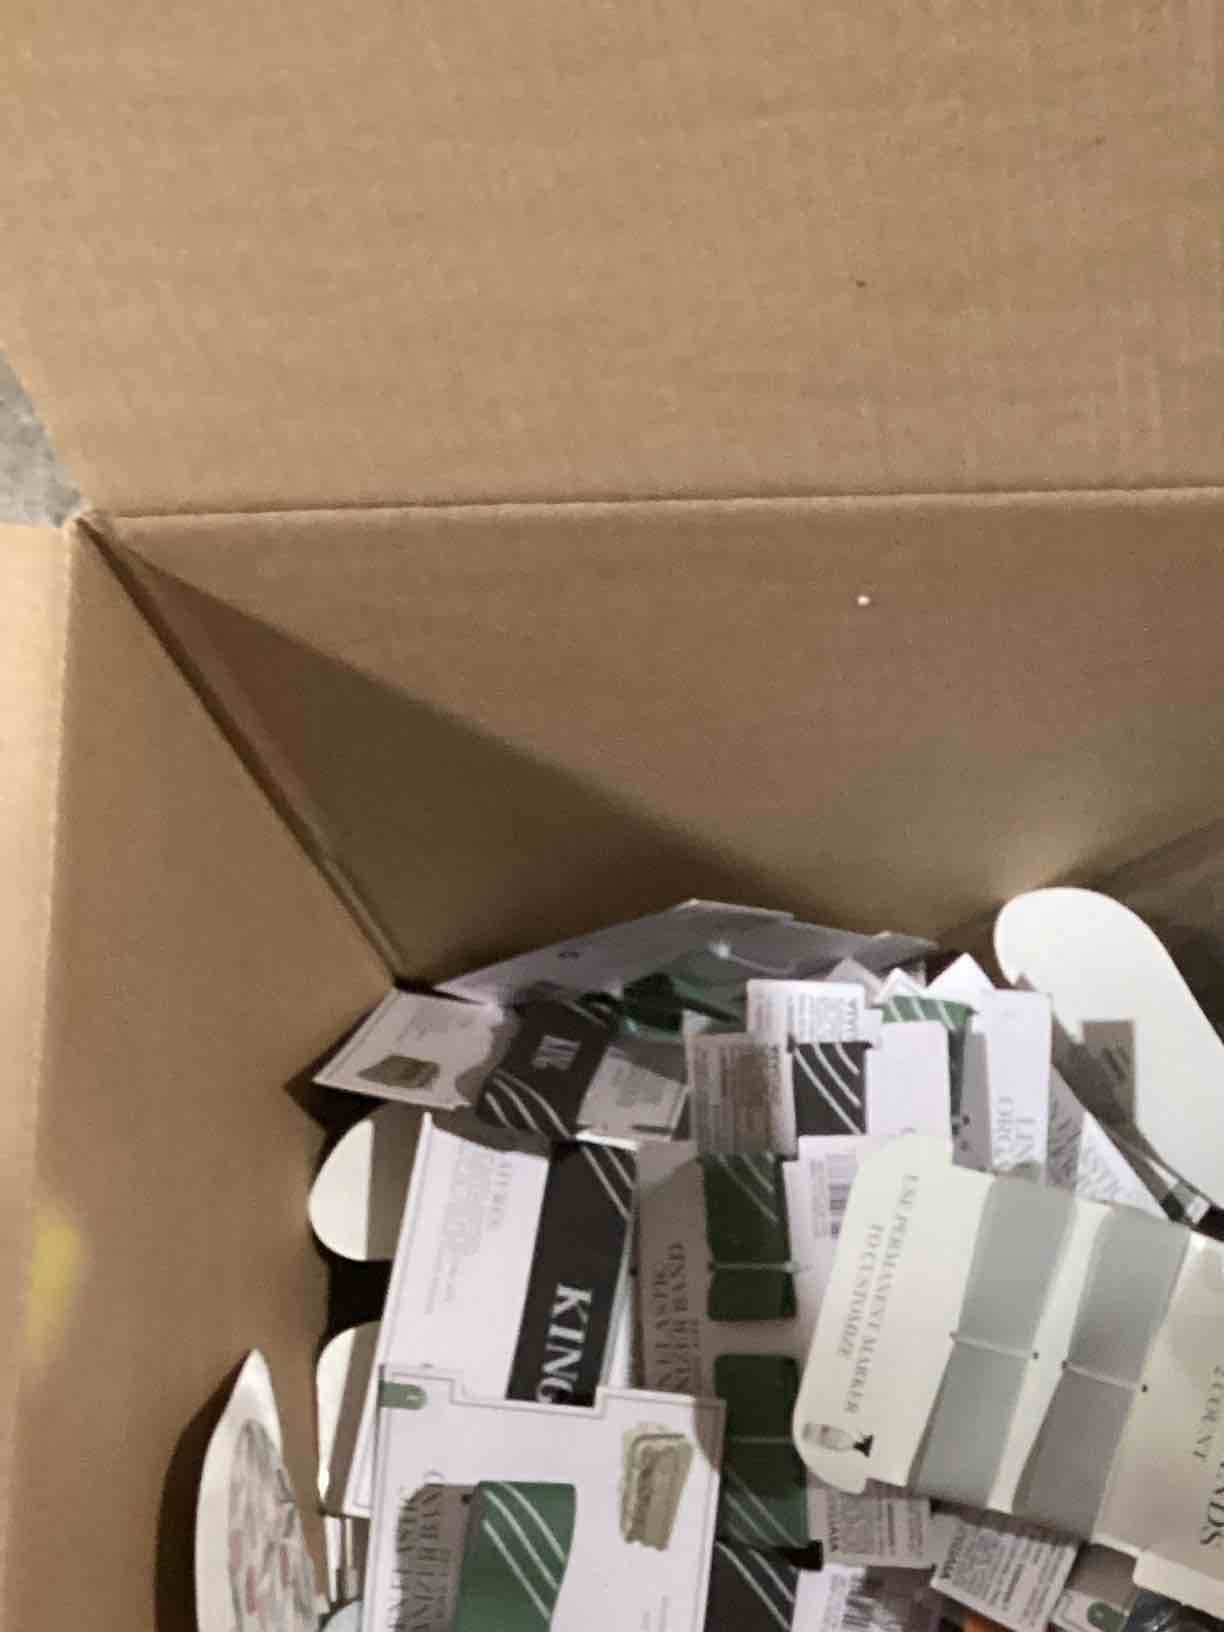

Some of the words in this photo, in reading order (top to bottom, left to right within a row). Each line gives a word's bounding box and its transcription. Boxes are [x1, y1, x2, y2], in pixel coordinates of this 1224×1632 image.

[837, 1253, 877, 1358] CUSTOMIZE
[868, 1211, 911, 1334] PERMANENT
[535, 1282, 593, 1404] KING
[842, 1335, 876, 1413] MARKER
